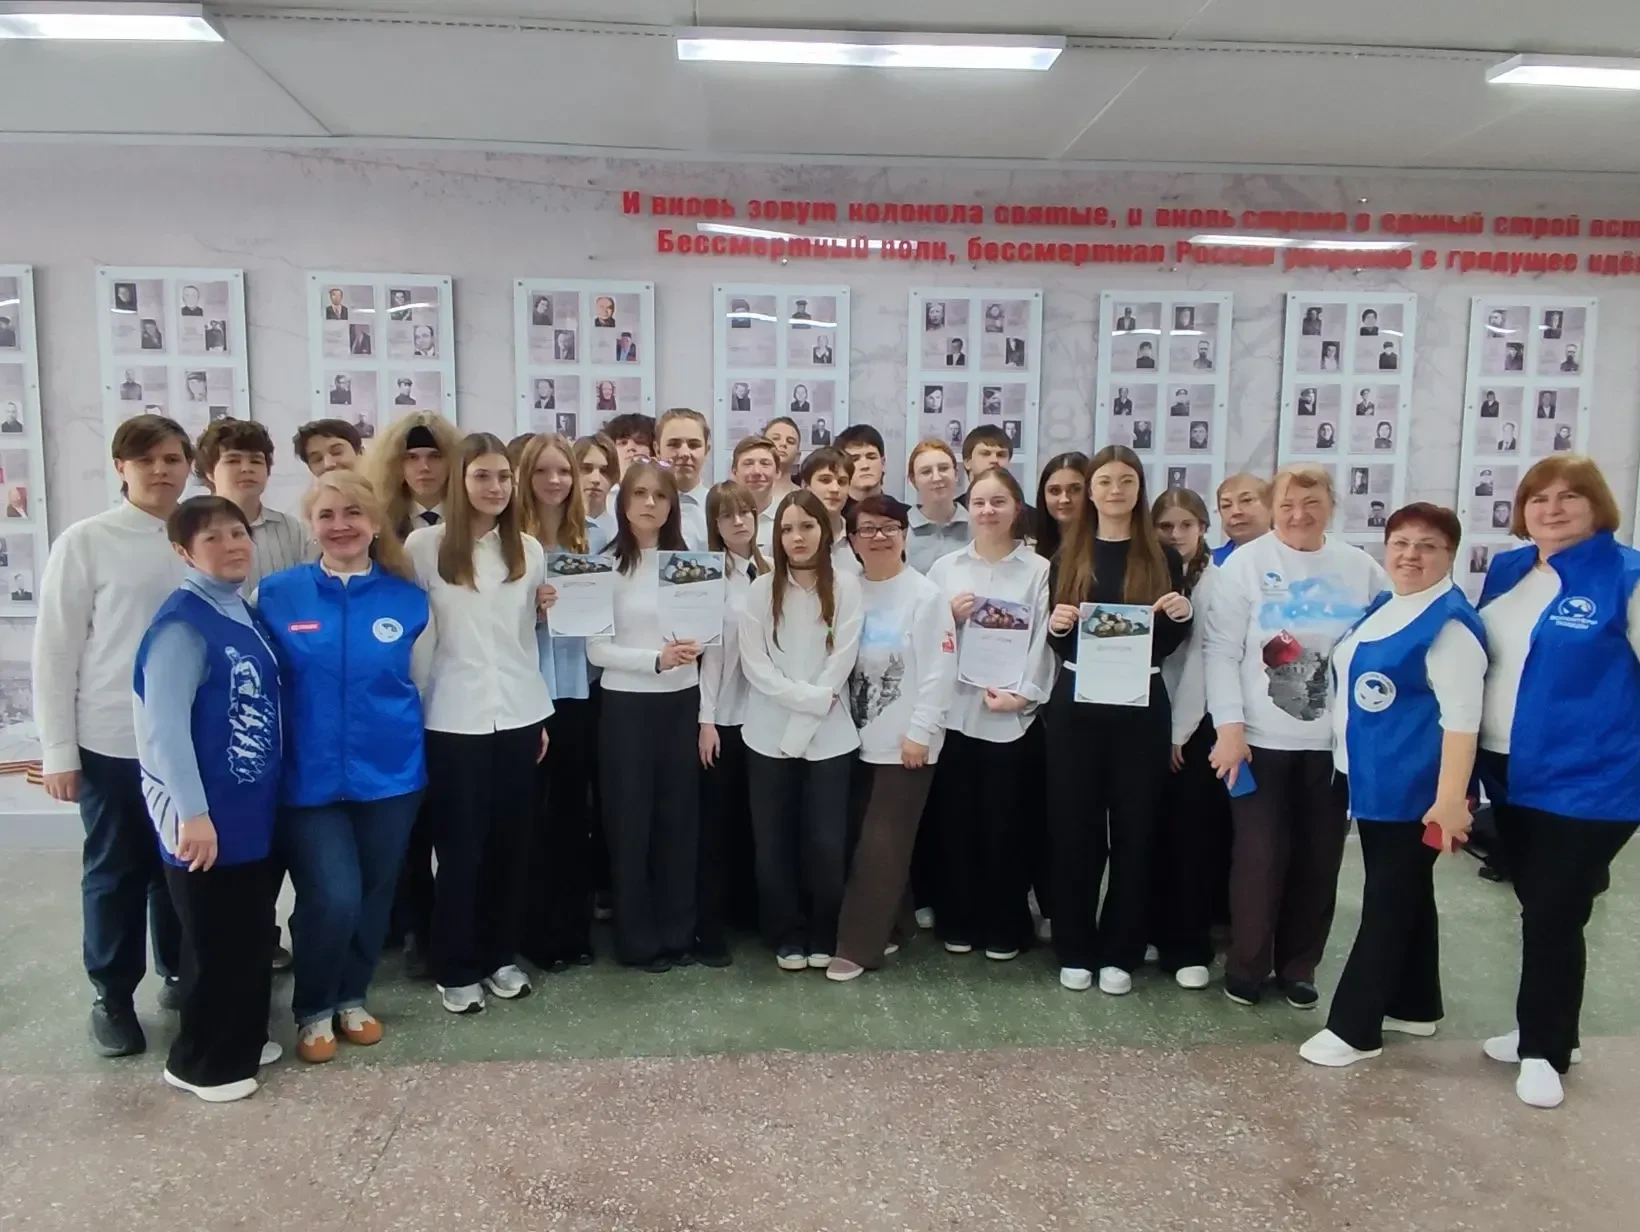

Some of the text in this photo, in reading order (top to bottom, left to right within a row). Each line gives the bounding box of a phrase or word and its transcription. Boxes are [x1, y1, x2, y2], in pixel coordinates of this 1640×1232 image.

[622, 191, 642, 214] И
[651, 196, 736, 217] вновь
[748, 200, 837, 224] зовут
[849, 203, 984, 224] колокола
[994, 205, 1118, 228] святые,
[1127, 208, 1143, 228] и
[1155, 208, 1237, 228] вновь
[1494, 214, 1581, 239] строй
[657, 229, 869, 261] Бессмертный
[967, 236, 1166, 266] бессмертная
[1421, 249, 1438, 269] в
[1588, 251, 1640, 276] идё
